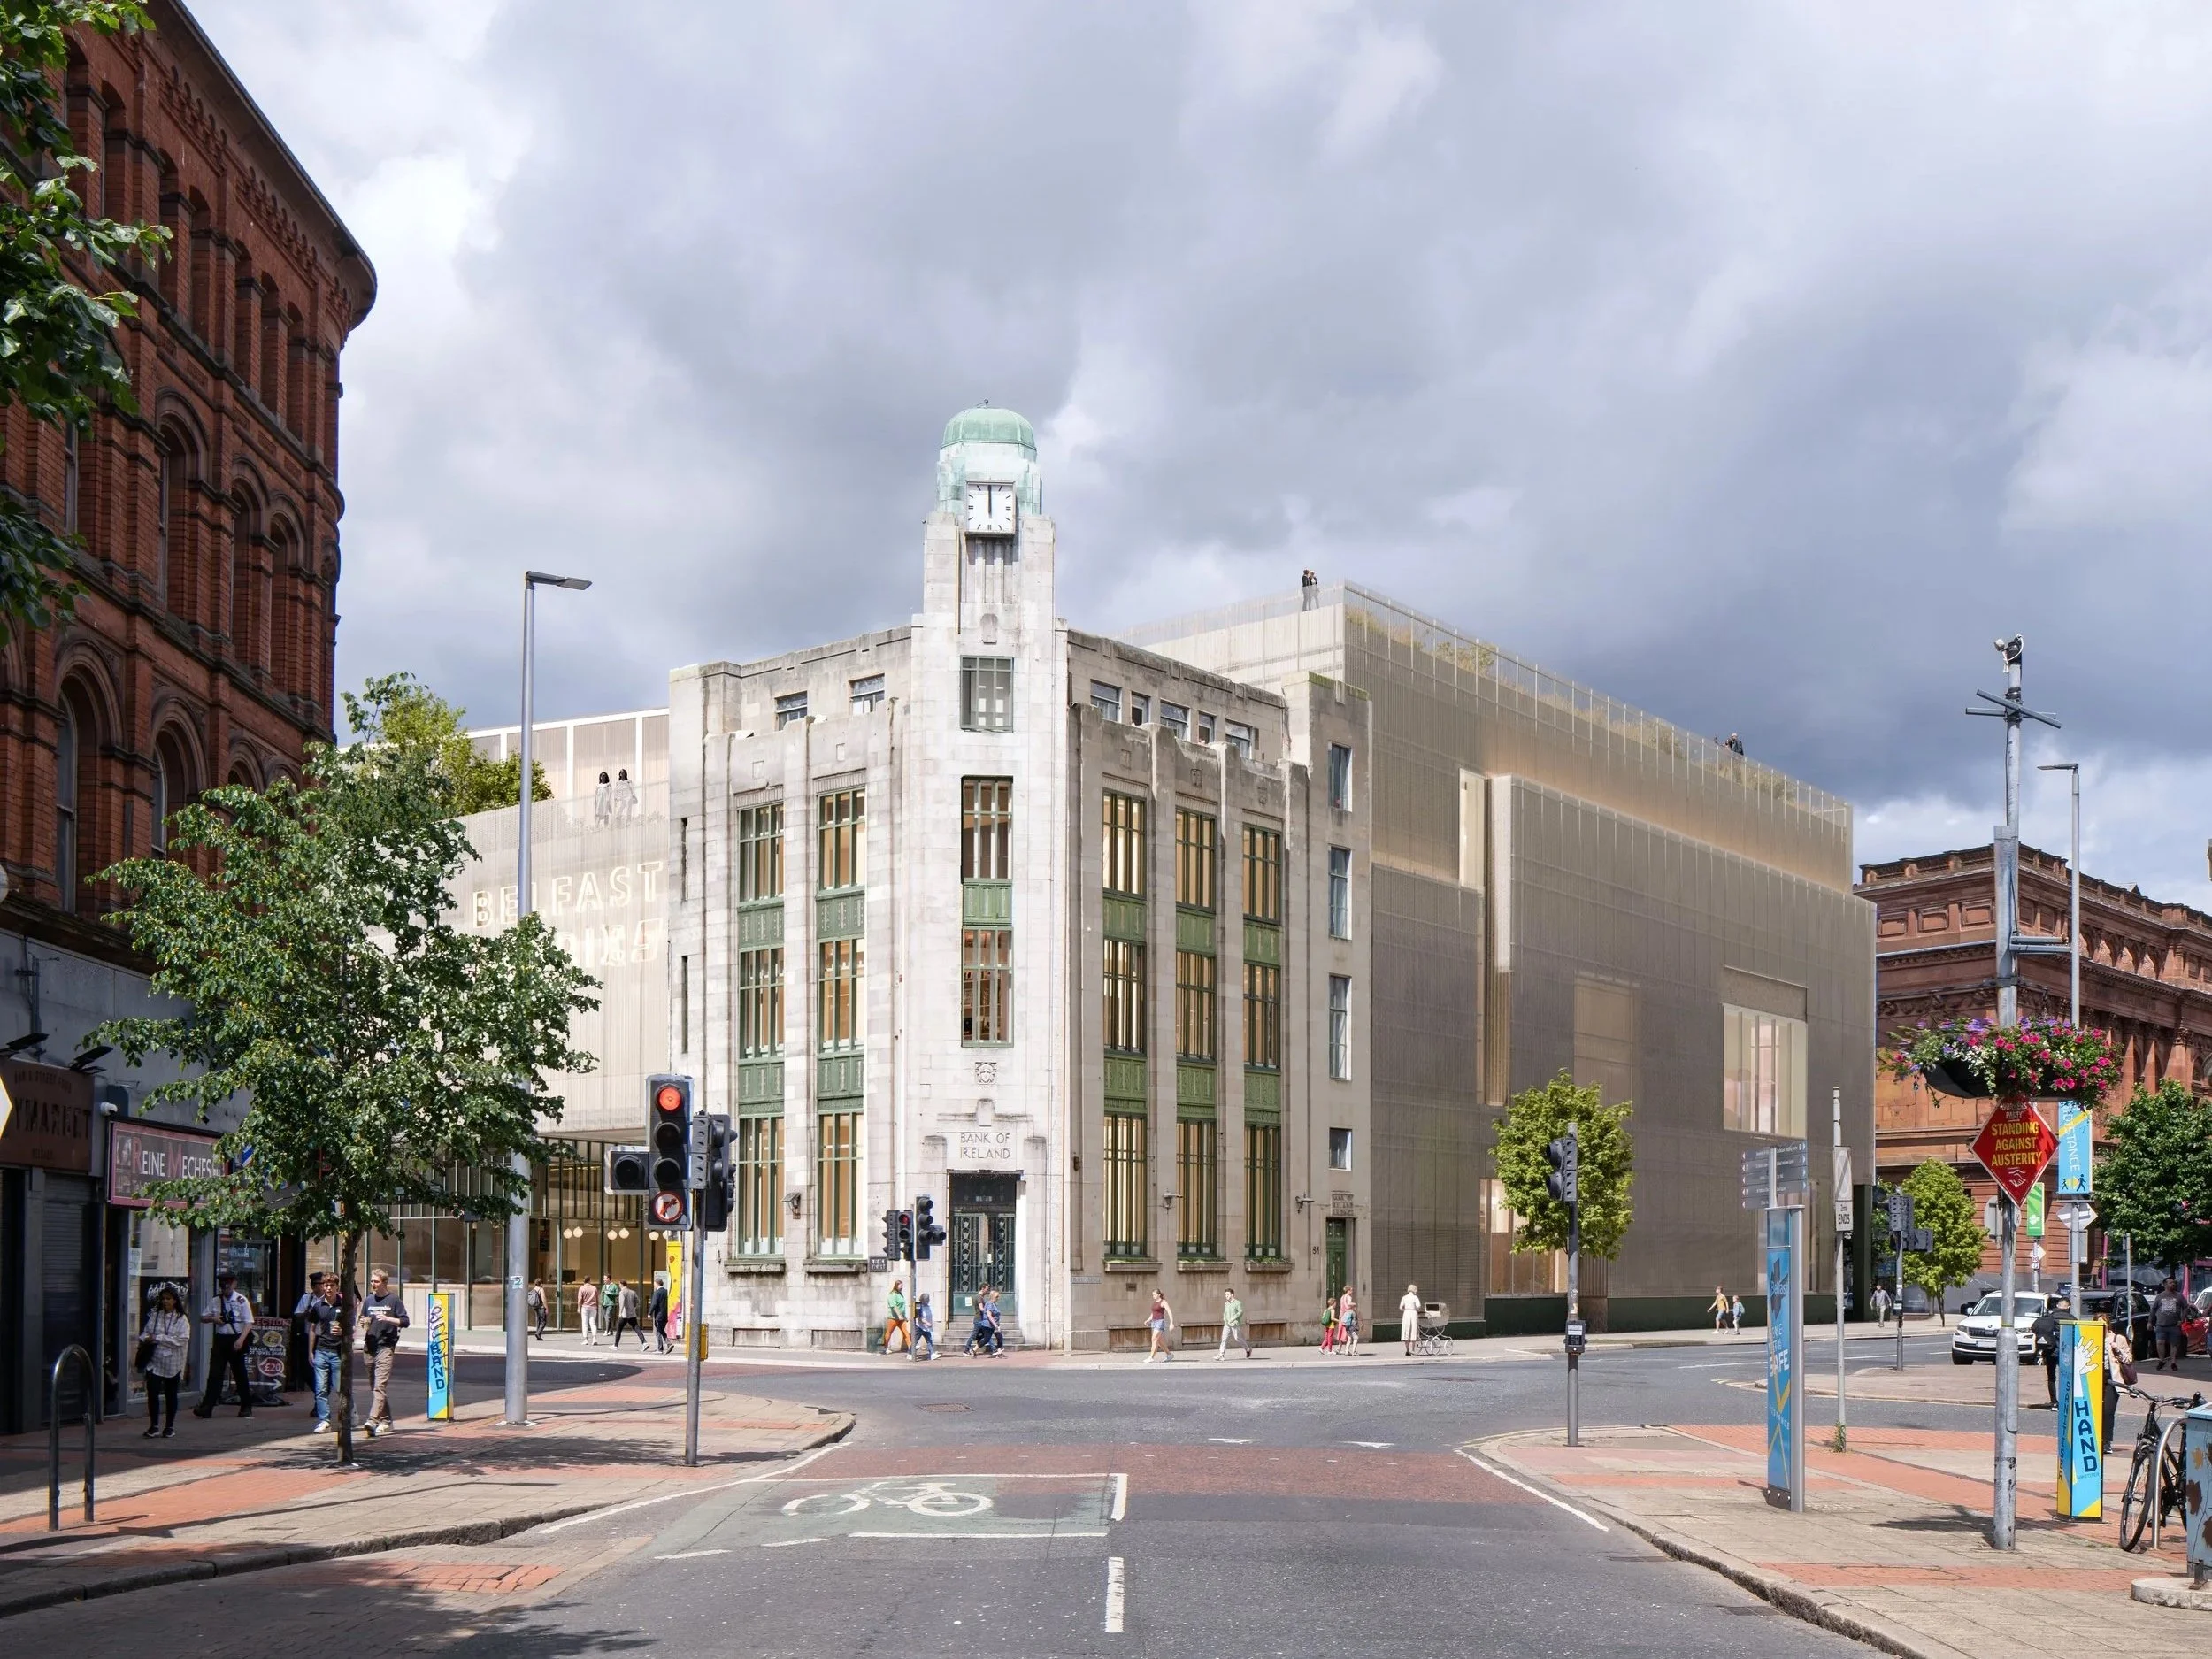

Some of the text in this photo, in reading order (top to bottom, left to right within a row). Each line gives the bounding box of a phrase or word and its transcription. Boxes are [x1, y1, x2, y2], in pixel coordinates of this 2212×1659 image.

[472, 860, 664, 929] BELFAST
[14, 1096, 92, 1141] YMARKET
[1991, 1121, 2039, 1136] STANDING
[960, 1133, 1010, 1144] BANK OF
[1995, 1137, 2037, 1151] AGAINST
[133, 1136, 212, 1179] REINE MECHES
[960, 1148, 1010, 1159] IRELAND
[1991, 1151, 2042, 1167] AUSTERITY
[1838, 1213, 1851, 1225] ENDS
[264, 1363, 281, 1372] £20
[1769, 1348, 1790, 1378] SAFE
[2057, 1381, 2071, 1480] SANITISER
[2075, 1400, 2098, 1472] HAND
